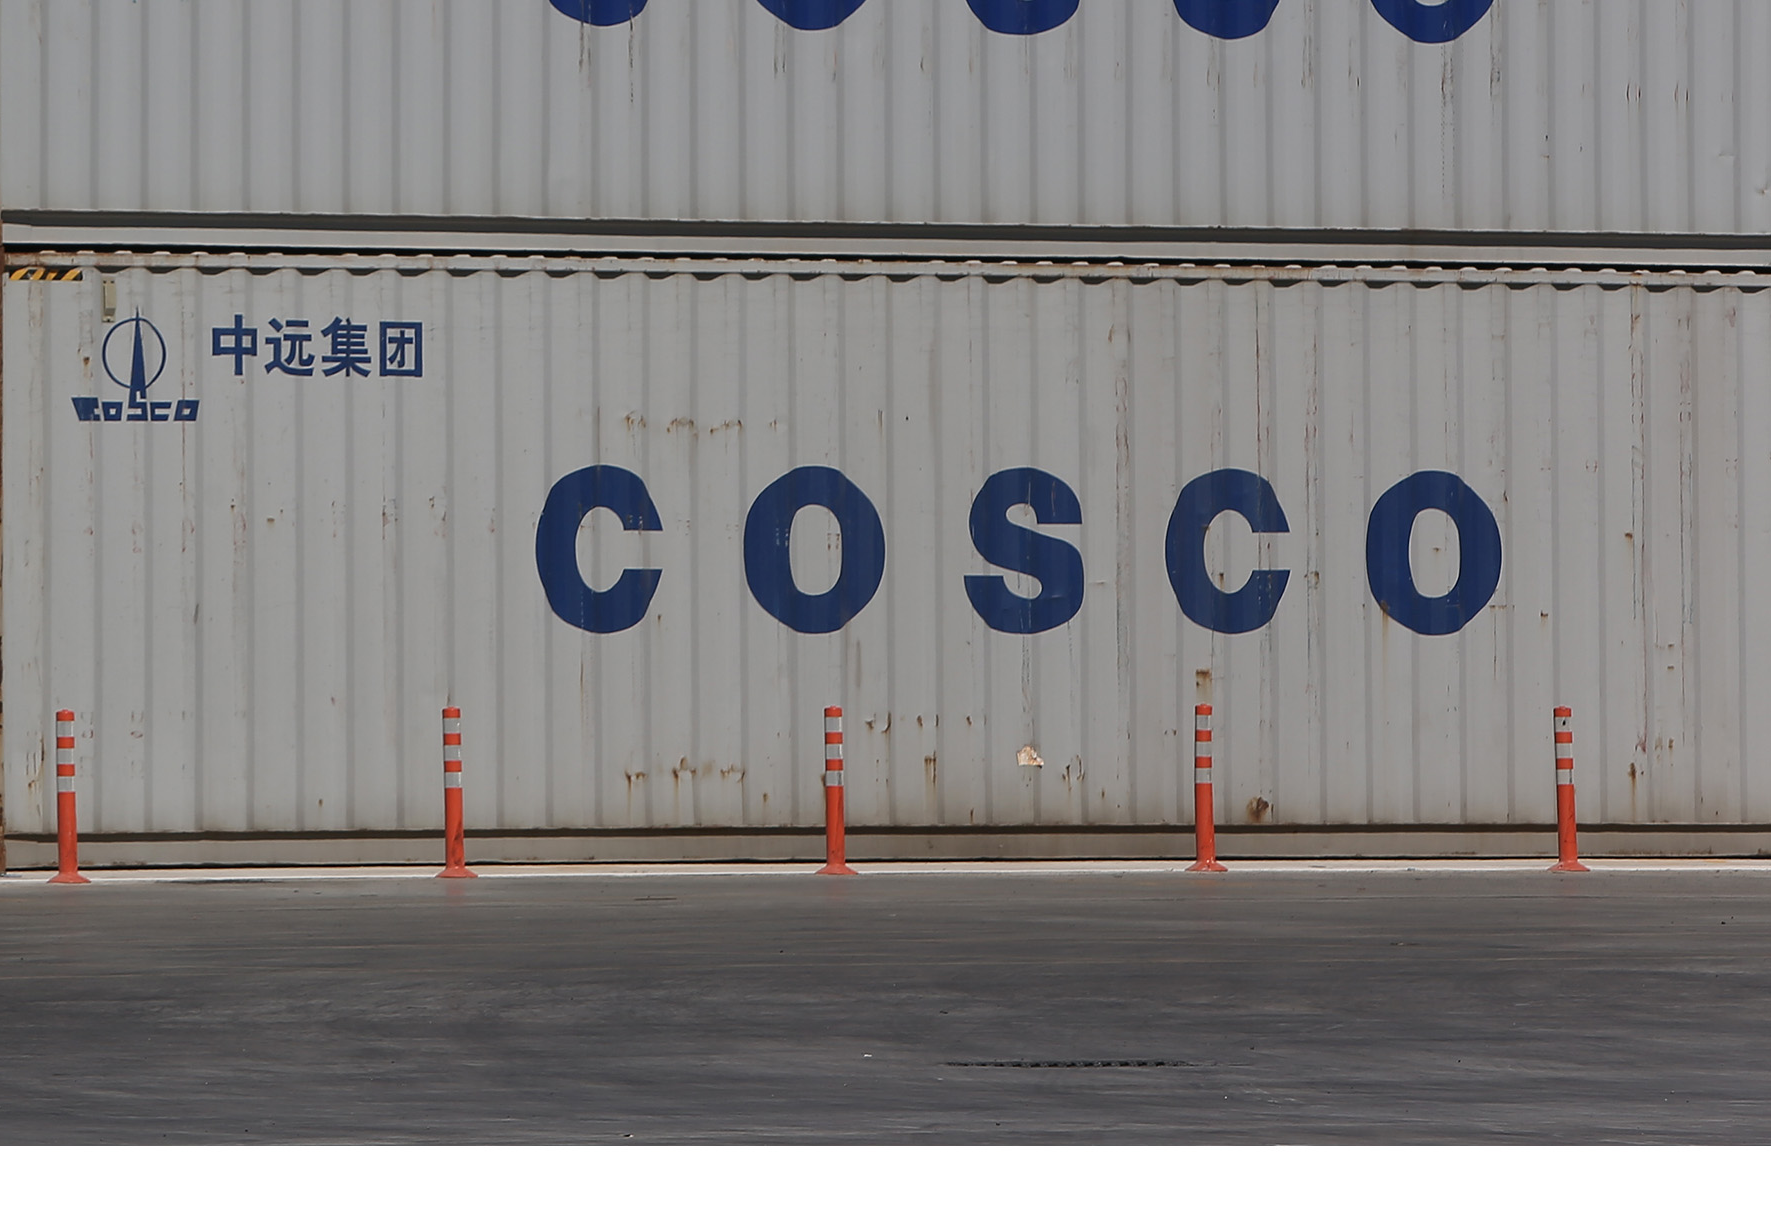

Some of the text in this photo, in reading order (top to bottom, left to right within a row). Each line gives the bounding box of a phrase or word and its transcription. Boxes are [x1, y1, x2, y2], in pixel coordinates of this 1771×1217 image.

[211, 314, 423, 377] 中远集团
[71, 396, 200, 421] COSCO
[537, 465, 1502, 635] COSCO
